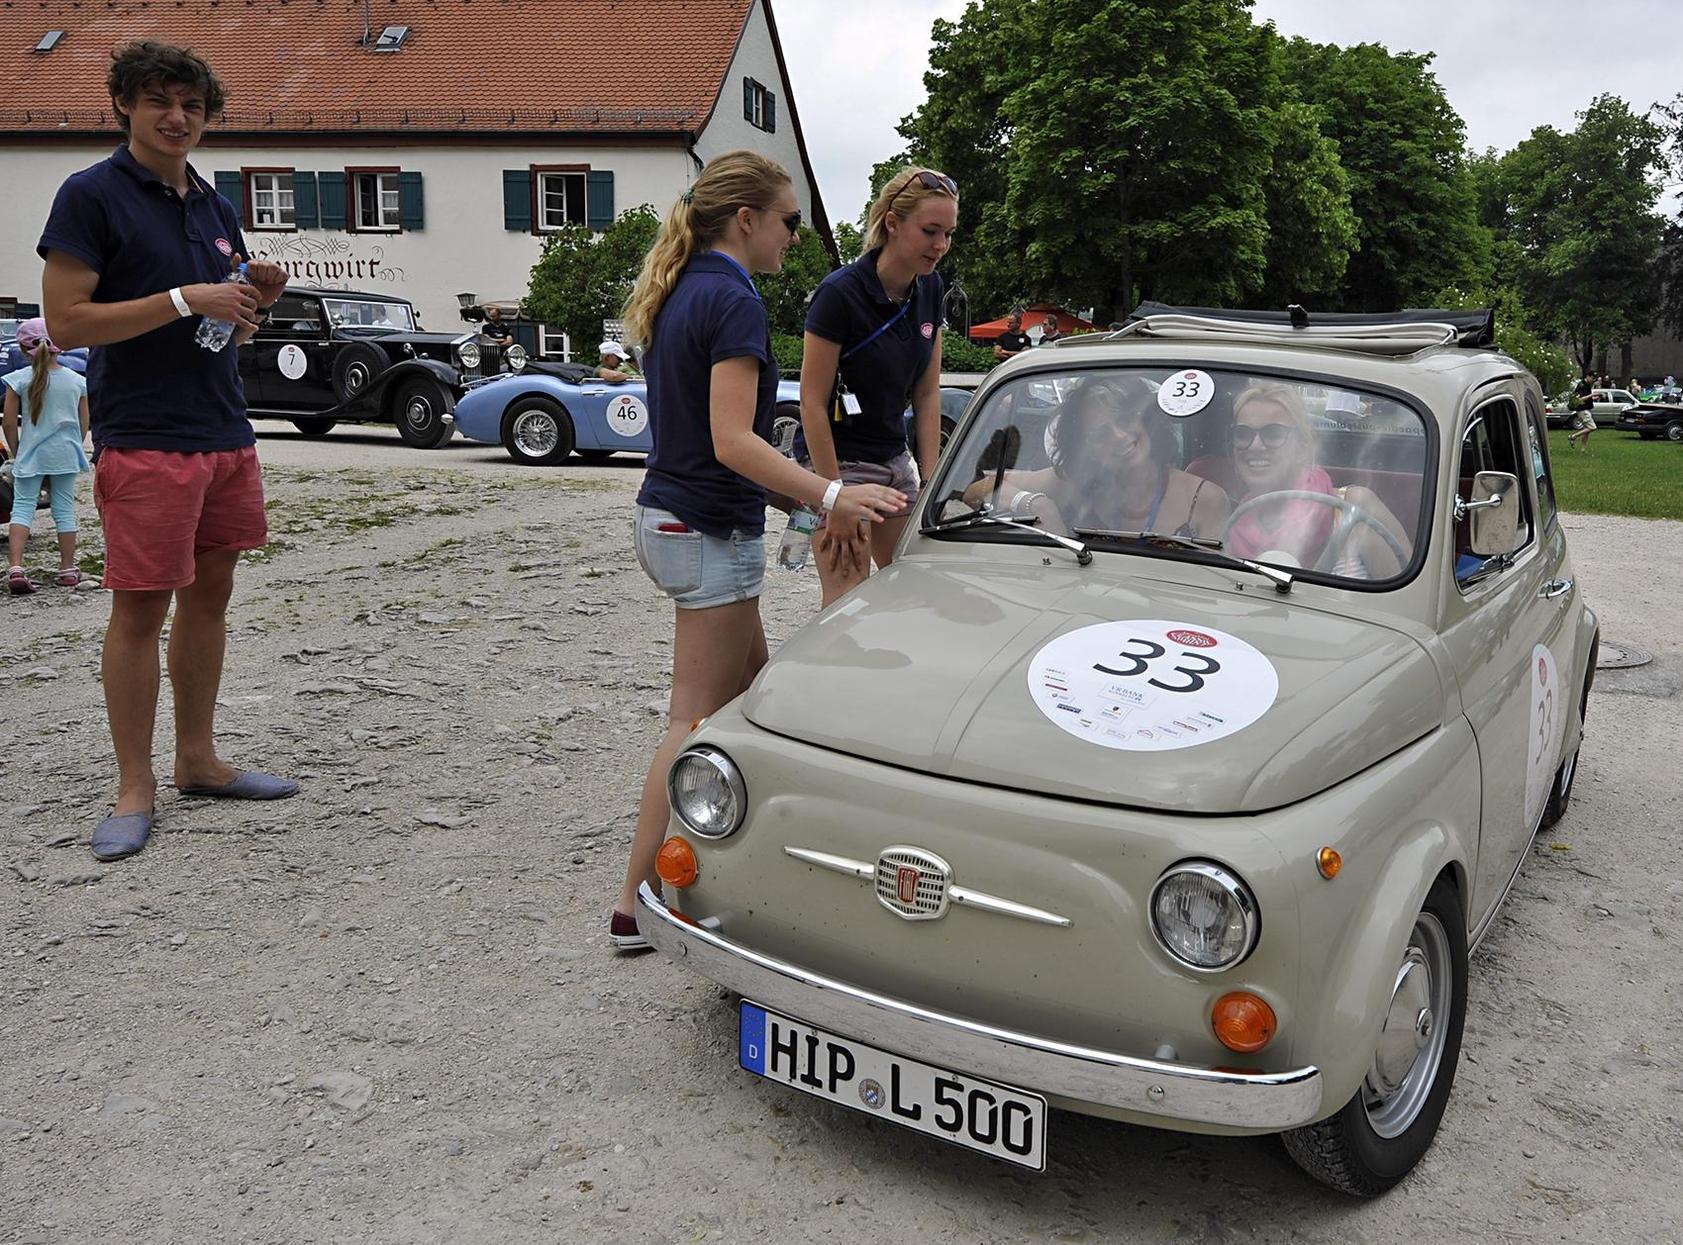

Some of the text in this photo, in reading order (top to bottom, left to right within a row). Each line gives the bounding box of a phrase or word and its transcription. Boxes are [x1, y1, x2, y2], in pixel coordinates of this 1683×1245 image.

[250, 250, 380, 287] urgwirt
[288, 353, 295, 365] 7
[1172, 381, 1200, 397] 33
[617, 405, 637, 420] 46
[1092, 638, 1221, 693] 33
[1535, 688, 1552, 765] 33
[748, 1044, 758, 1059] D
[771, 1022, 1033, 1156] HIP L 500
